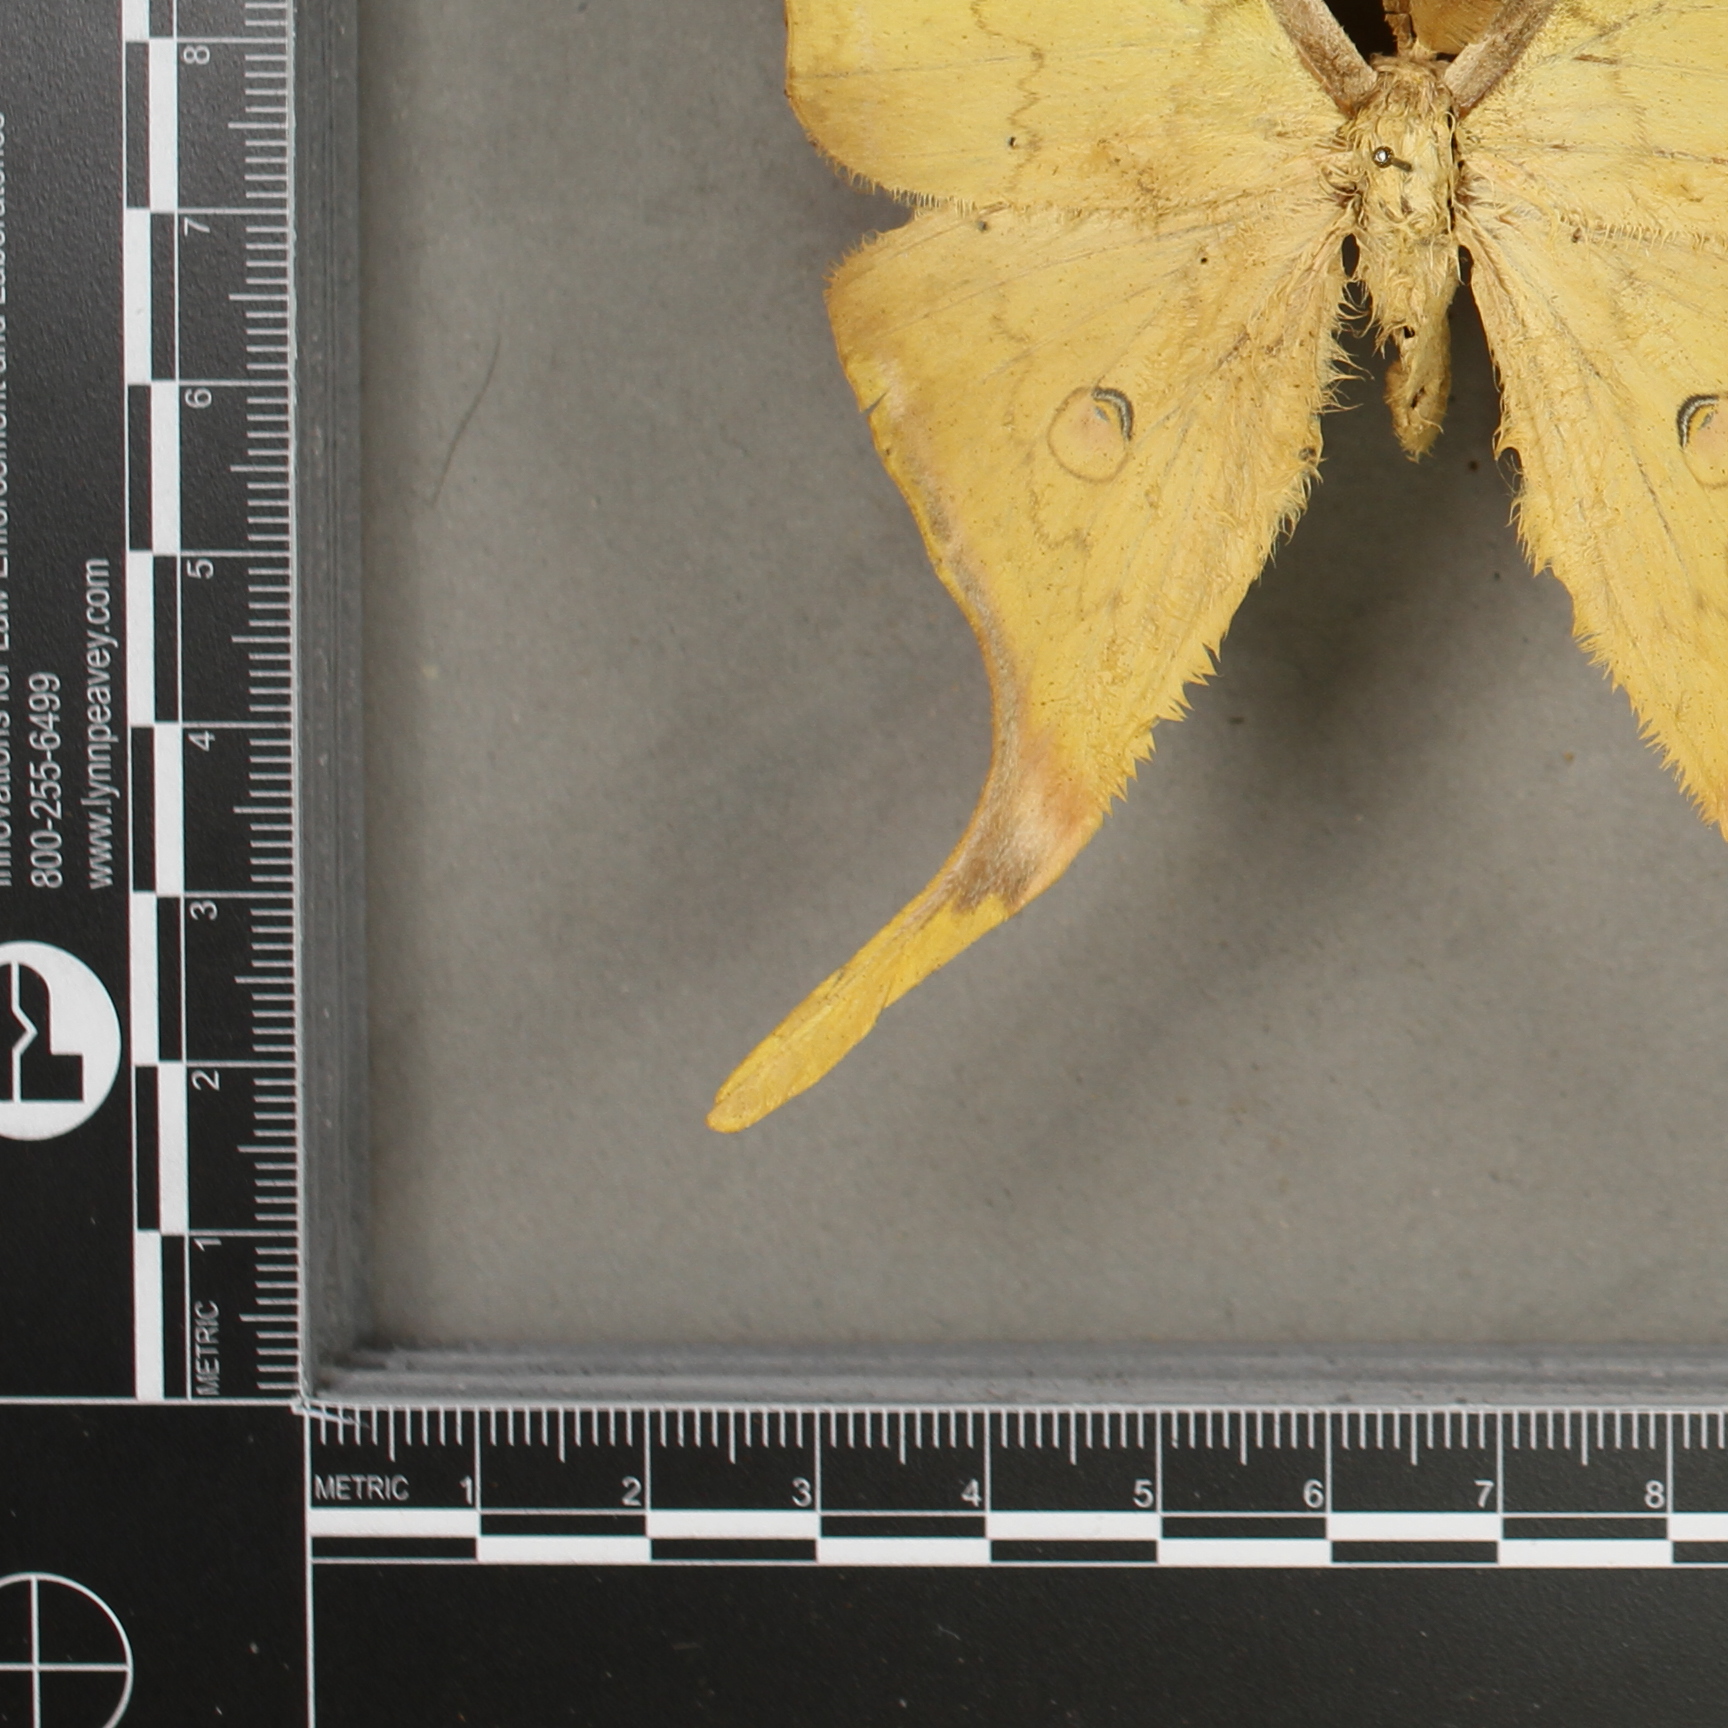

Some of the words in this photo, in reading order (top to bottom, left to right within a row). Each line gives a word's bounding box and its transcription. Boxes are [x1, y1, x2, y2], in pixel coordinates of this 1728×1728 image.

[183, 44, 210, 65] 8
[184, 216, 210, 236] 7
[185, 388, 212, 409] 6
[187, 558, 214, 579] 5
[81, 558, 120, 890] www.lynnpeavey.com
[188, 730, 215, 751] 4
[29, 672, 63, 889] 800-255-6499
[190, 900, 218, 921] 3
[192, 1069, 220, 1091] 2
[194, 1237, 221, 1252] 1
[195, 1300, 220, 1397] METRIC
[315, 1475, 409, 1503] METRIC
[459, 1477, 473, 1504] 1
[623, 1478, 641, 1505] 2
[793, 1479, 811, 1506] 3
[962, 1480, 981, 1506] 4
[1134, 1480, 1153, 1507] 5
[1304, 1480, 1323, 1508] 6
[1475, 1480, 1494, 1507] 7
[1645, 1480, 1665, 1508] 8
